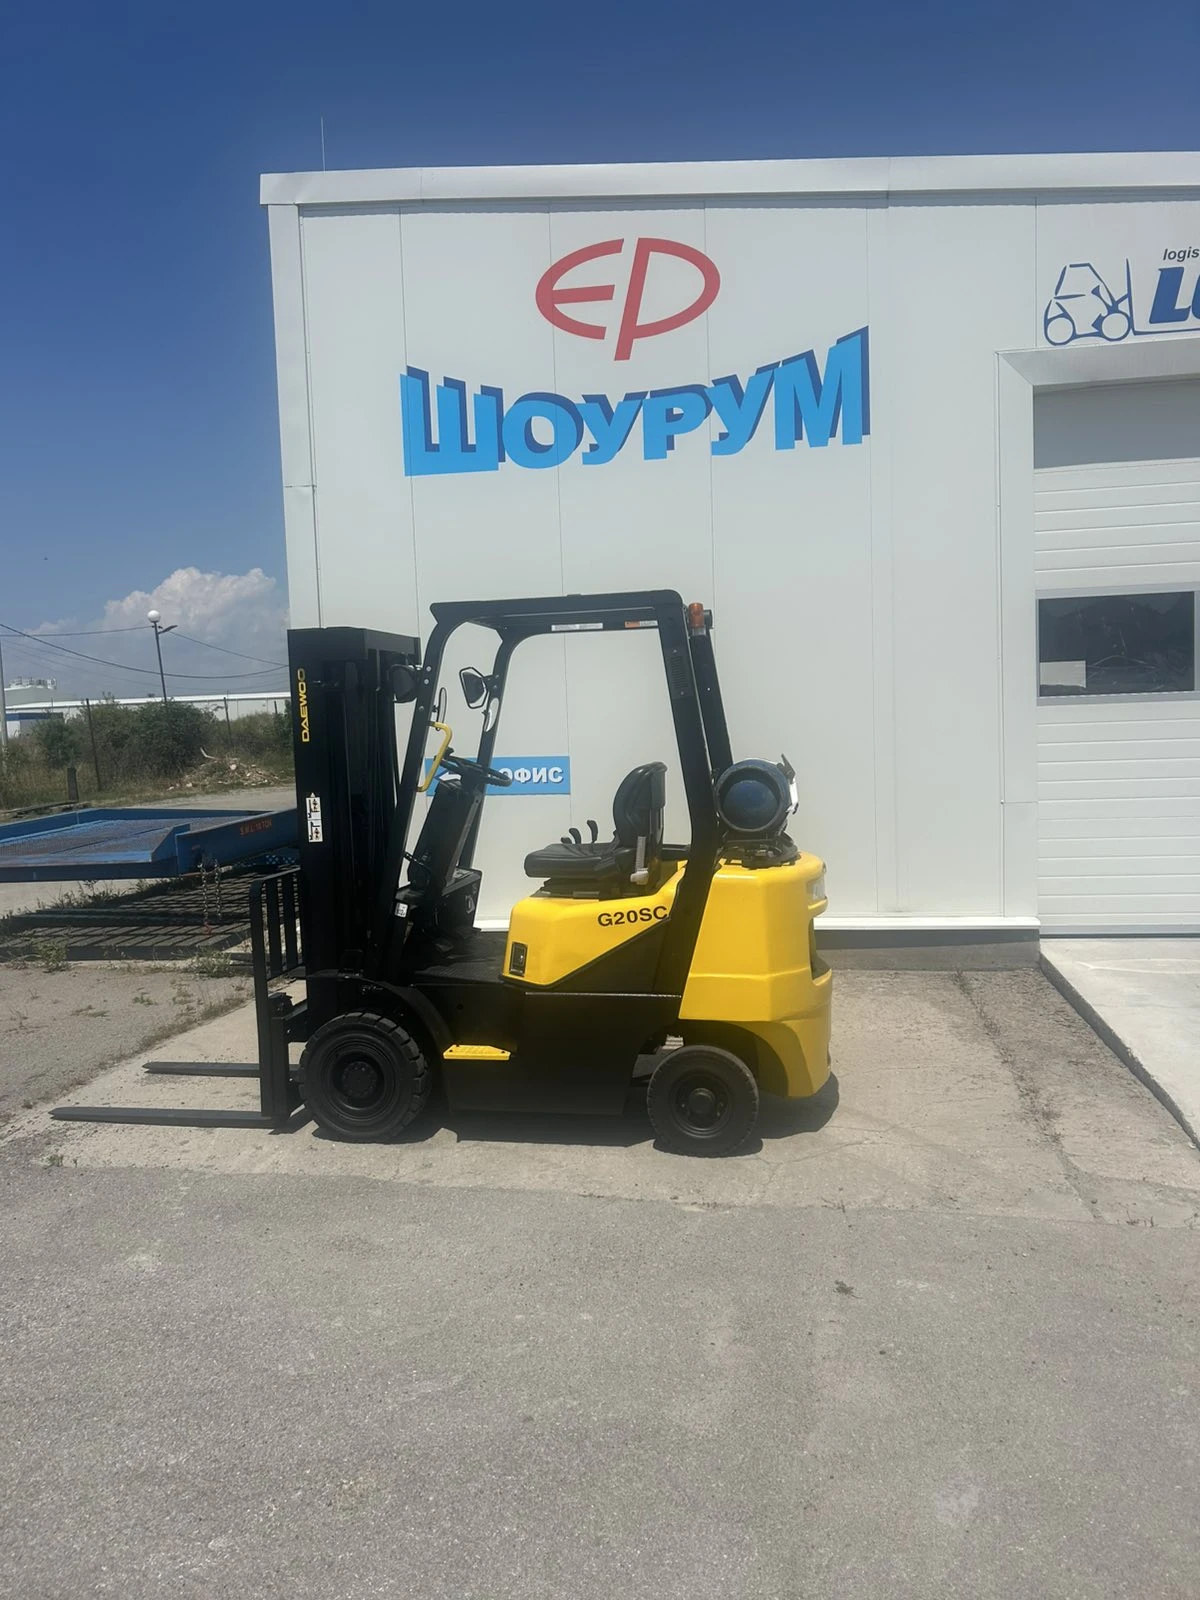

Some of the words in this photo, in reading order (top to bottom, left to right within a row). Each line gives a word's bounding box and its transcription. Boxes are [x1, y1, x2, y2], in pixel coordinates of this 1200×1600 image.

[1149, 266, 1200, 324] L
[400, 325, 871, 476] ШОУРУМ
[298, 668, 310, 742] DAEWOO
[597, 905, 668, 927] G20SC
